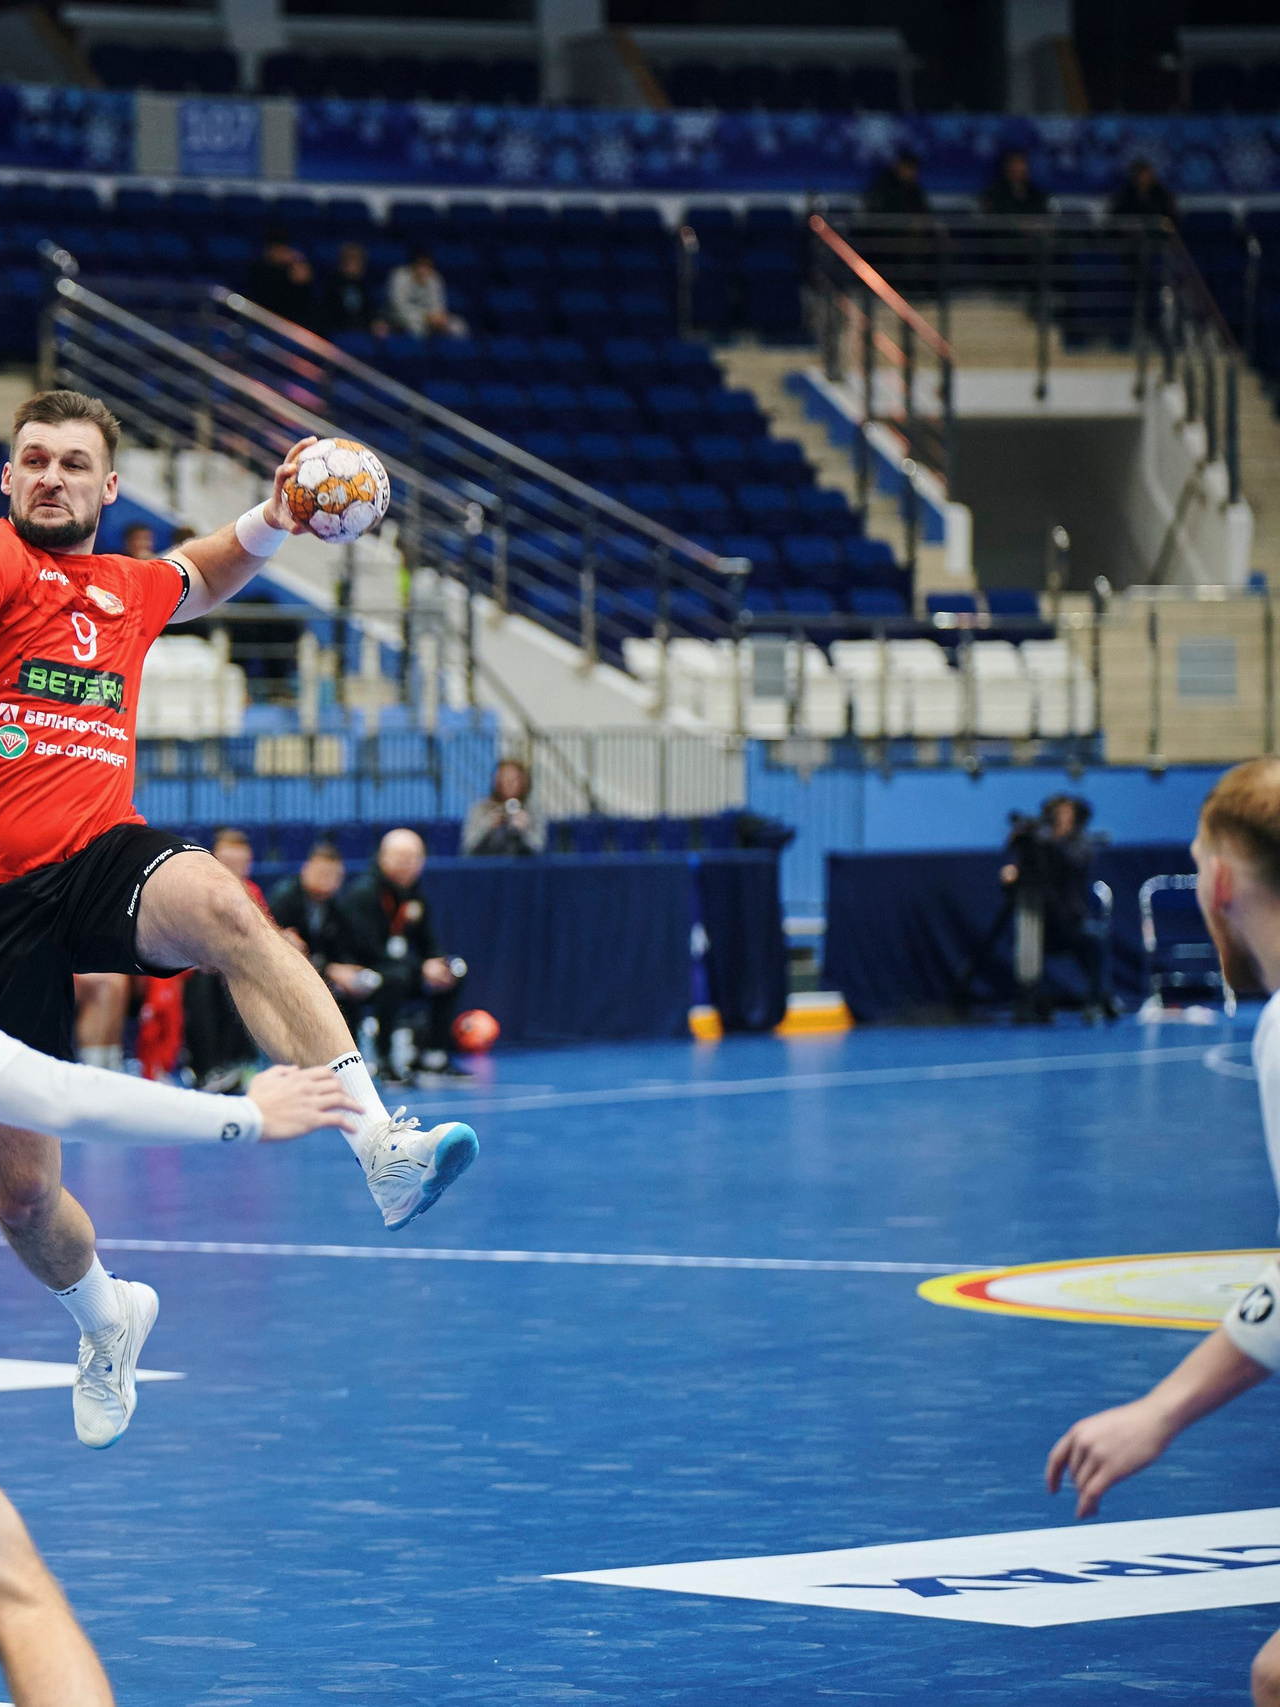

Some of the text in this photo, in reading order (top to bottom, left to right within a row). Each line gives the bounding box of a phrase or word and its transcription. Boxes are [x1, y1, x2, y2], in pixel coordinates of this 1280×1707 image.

[39, 568, 70, 586] Kemp
[71, 611, 97, 661] 9
[24, 710, 129, 741] БЕЛНЕФТСТРХ
[34, 741, 127, 769] BELORUSNEFT
[143, 848, 173, 876] Kempa
[331, 1055, 362, 1073] emp
